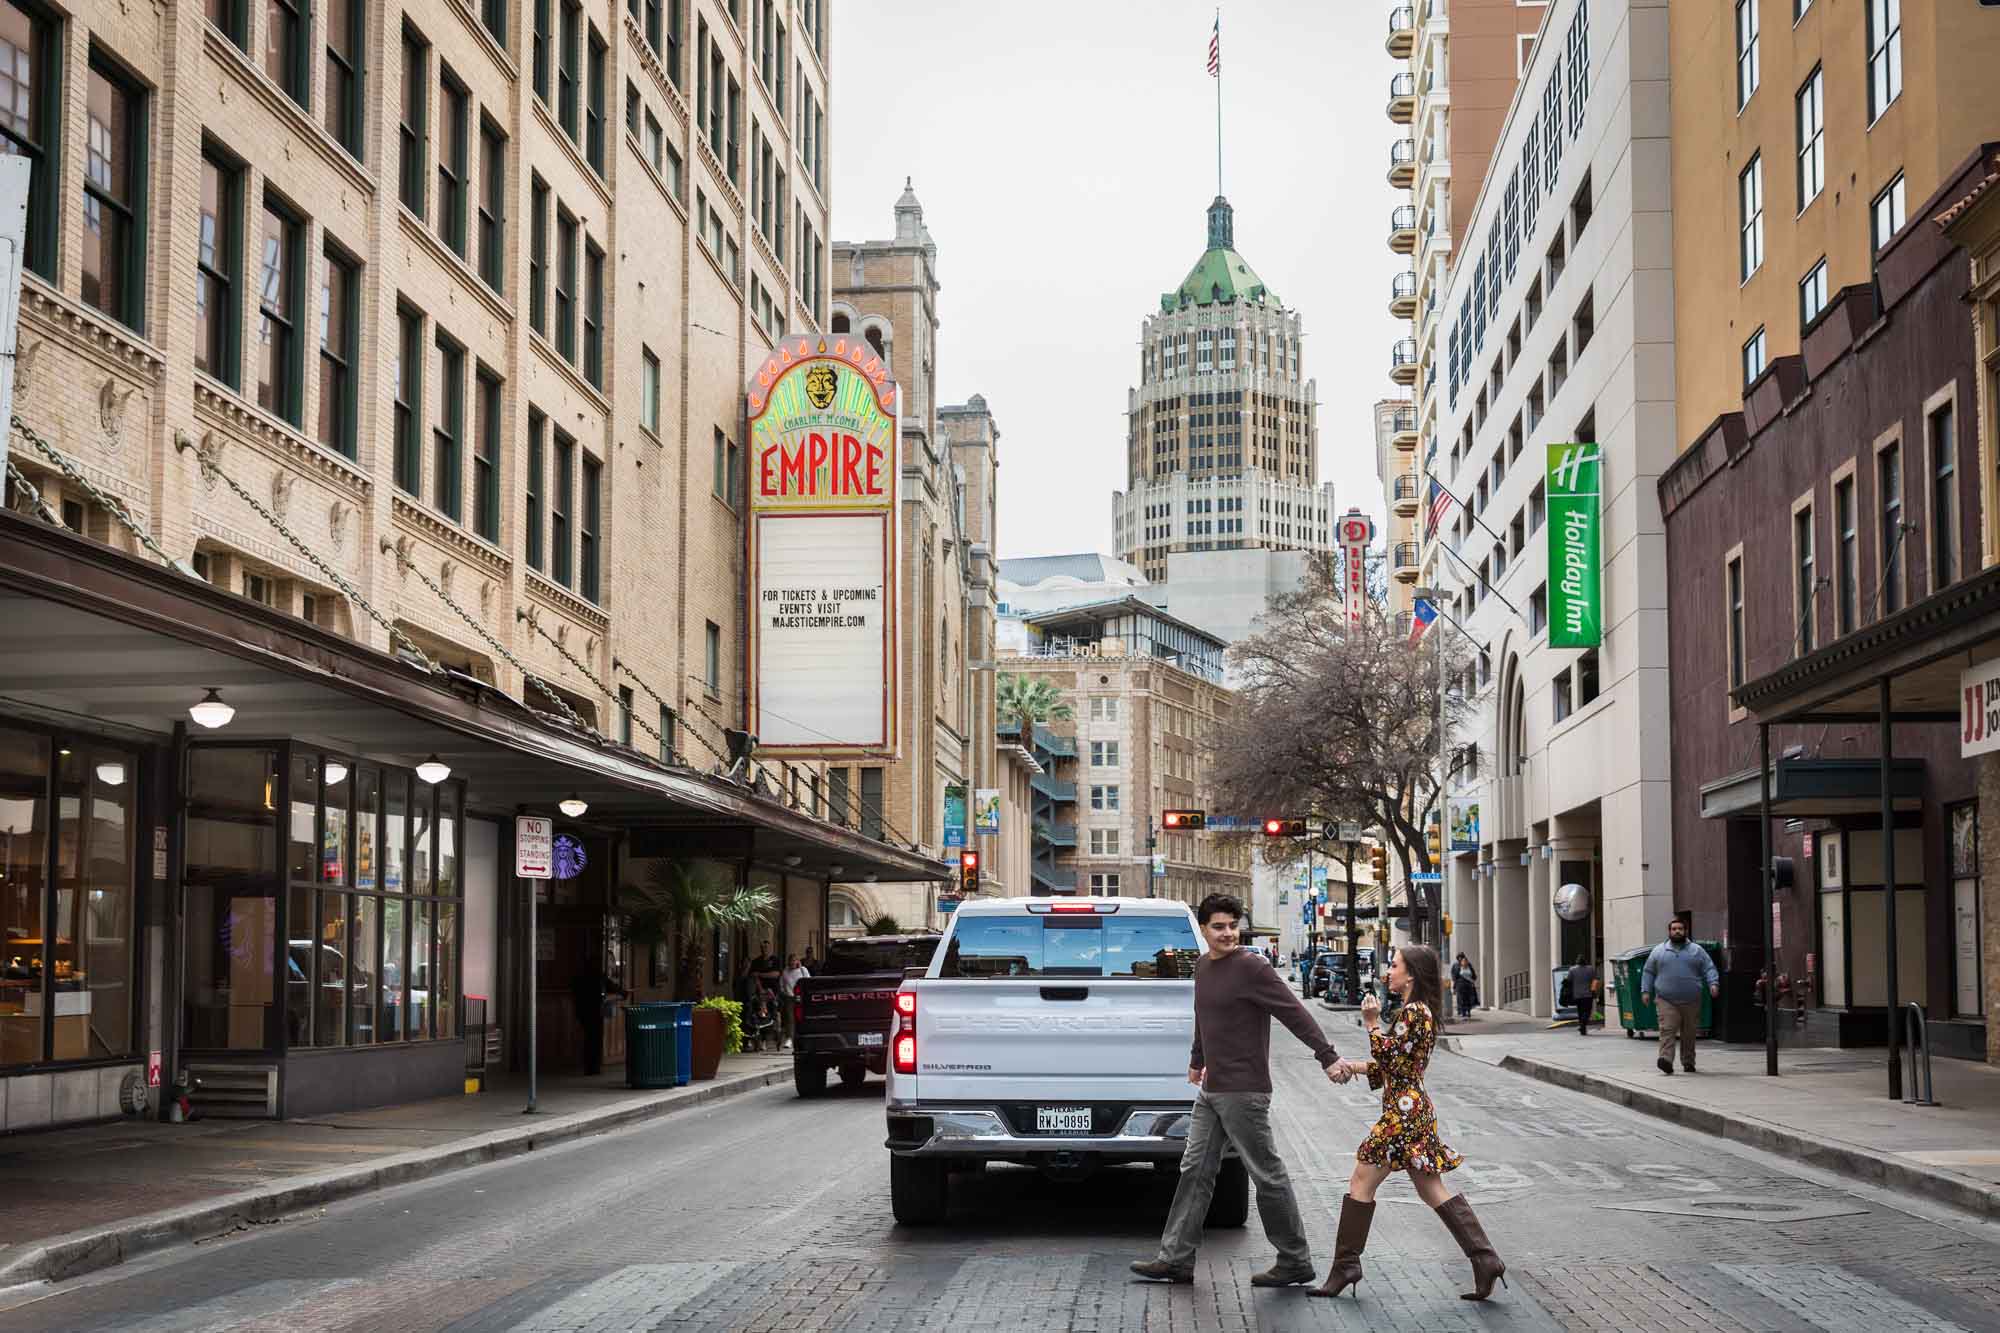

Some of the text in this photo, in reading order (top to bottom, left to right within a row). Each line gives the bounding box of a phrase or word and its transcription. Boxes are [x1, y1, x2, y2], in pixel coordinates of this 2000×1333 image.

[760, 432, 883, 496] EMPIRE
[1560, 509, 1589, 634] Holiday Inn
[763, 589, 876, 601] FOR TICKETS & UPCOMING
[780, 603, 841, 614] EVENTS VISIT
[772, 616, 865, 628] MAJESTICEMPIRE.COM
[1964, 684, 1984, 744] JJ
[527, 821, 542, 834] NO
[520, 833, 549, 844] STOPPING
[520, 849, 550, 859] STANDING
[922, 1063, 992, 1071] SILVERADO
